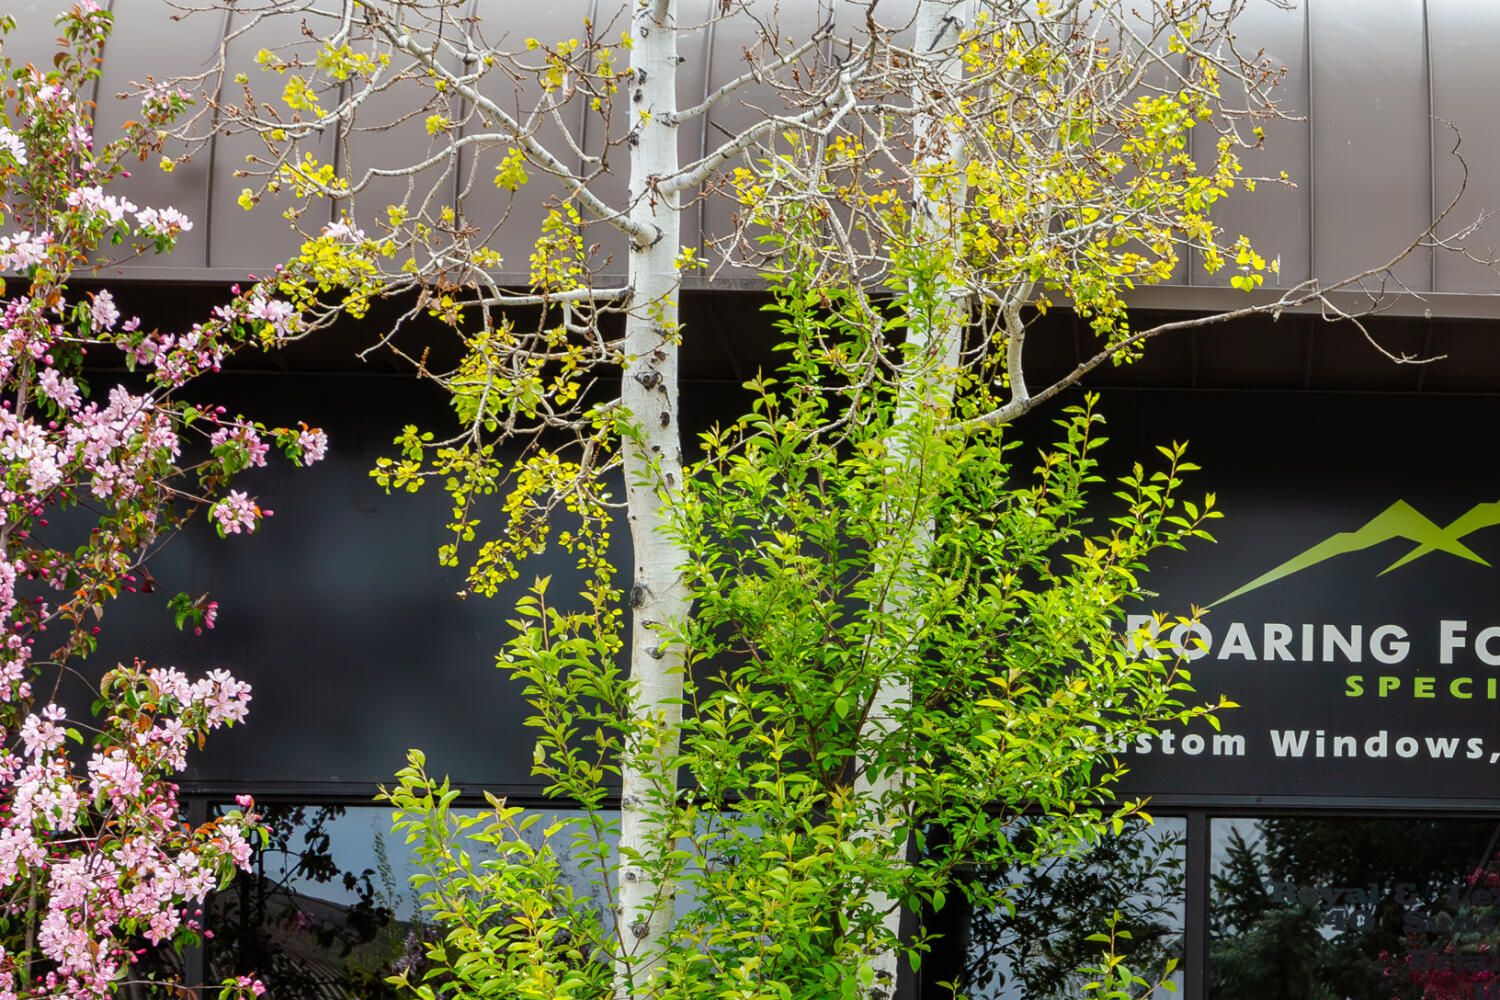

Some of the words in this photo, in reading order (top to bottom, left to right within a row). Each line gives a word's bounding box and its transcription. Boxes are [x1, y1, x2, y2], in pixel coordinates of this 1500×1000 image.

[1127, 614, 1411, 665] ROARING
[1271, 881, 1381, 910] Royal
[1325, 910, 1376, 932] 40
